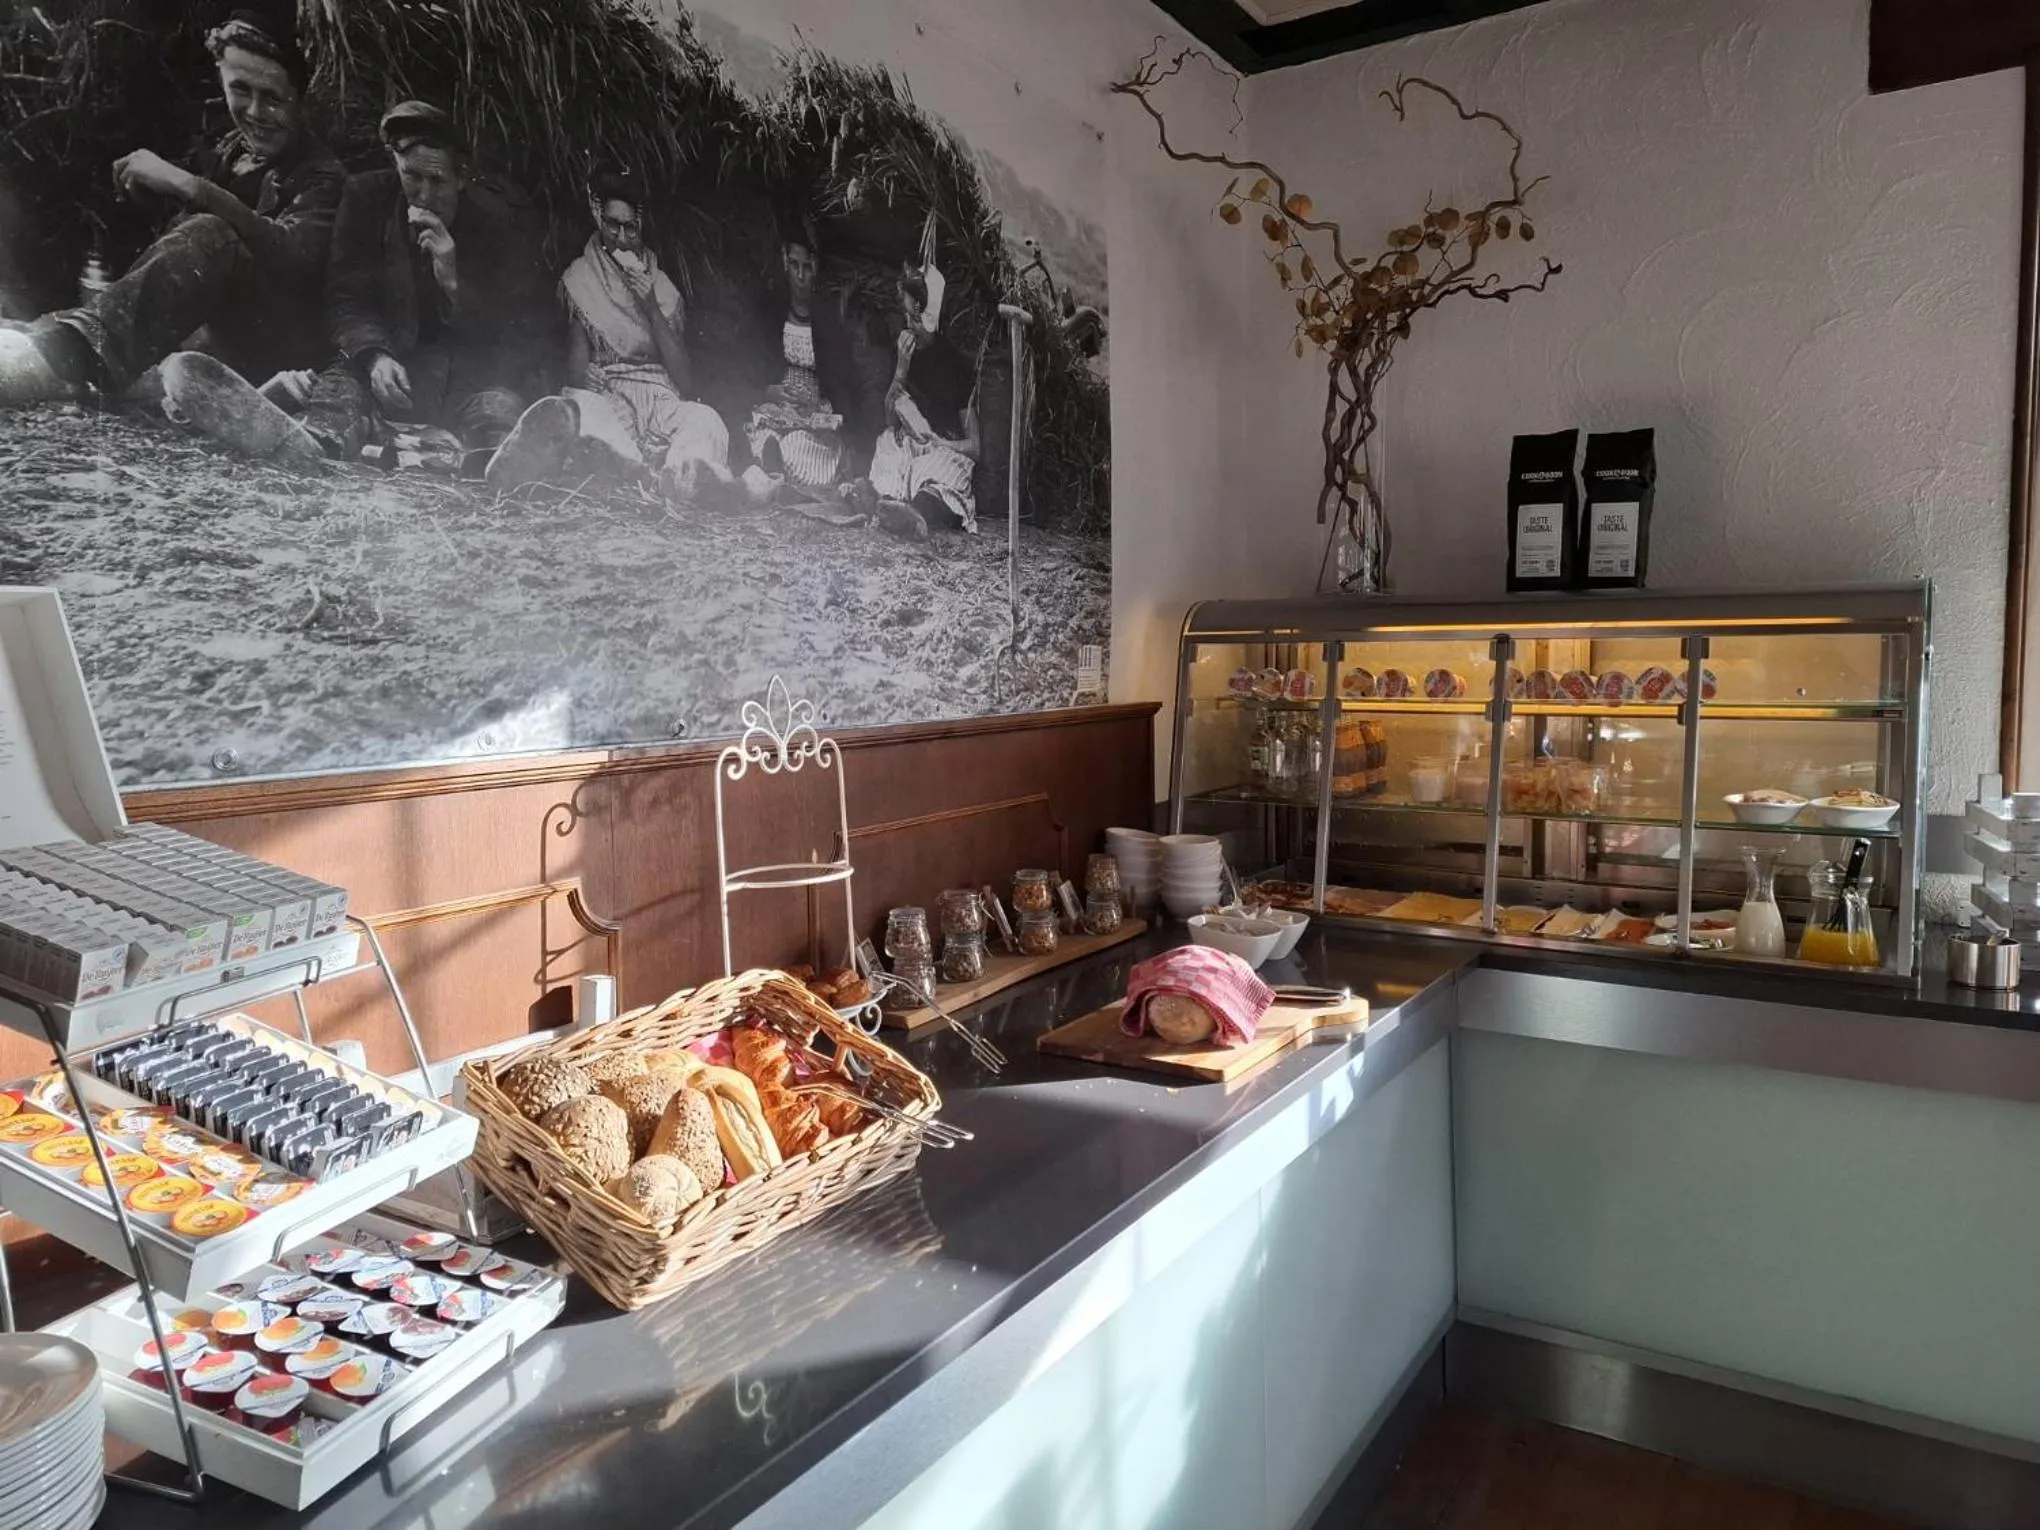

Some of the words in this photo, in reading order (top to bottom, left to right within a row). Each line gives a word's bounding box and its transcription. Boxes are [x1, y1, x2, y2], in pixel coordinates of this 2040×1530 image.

[1529, 516, 1549, 525] TASTE
[1603, 514, 1624, 523] TASTE
[1523, 524, 1553, 534] ORIGINAL
[1597, 523, 1628, 532] ORIGINAL
